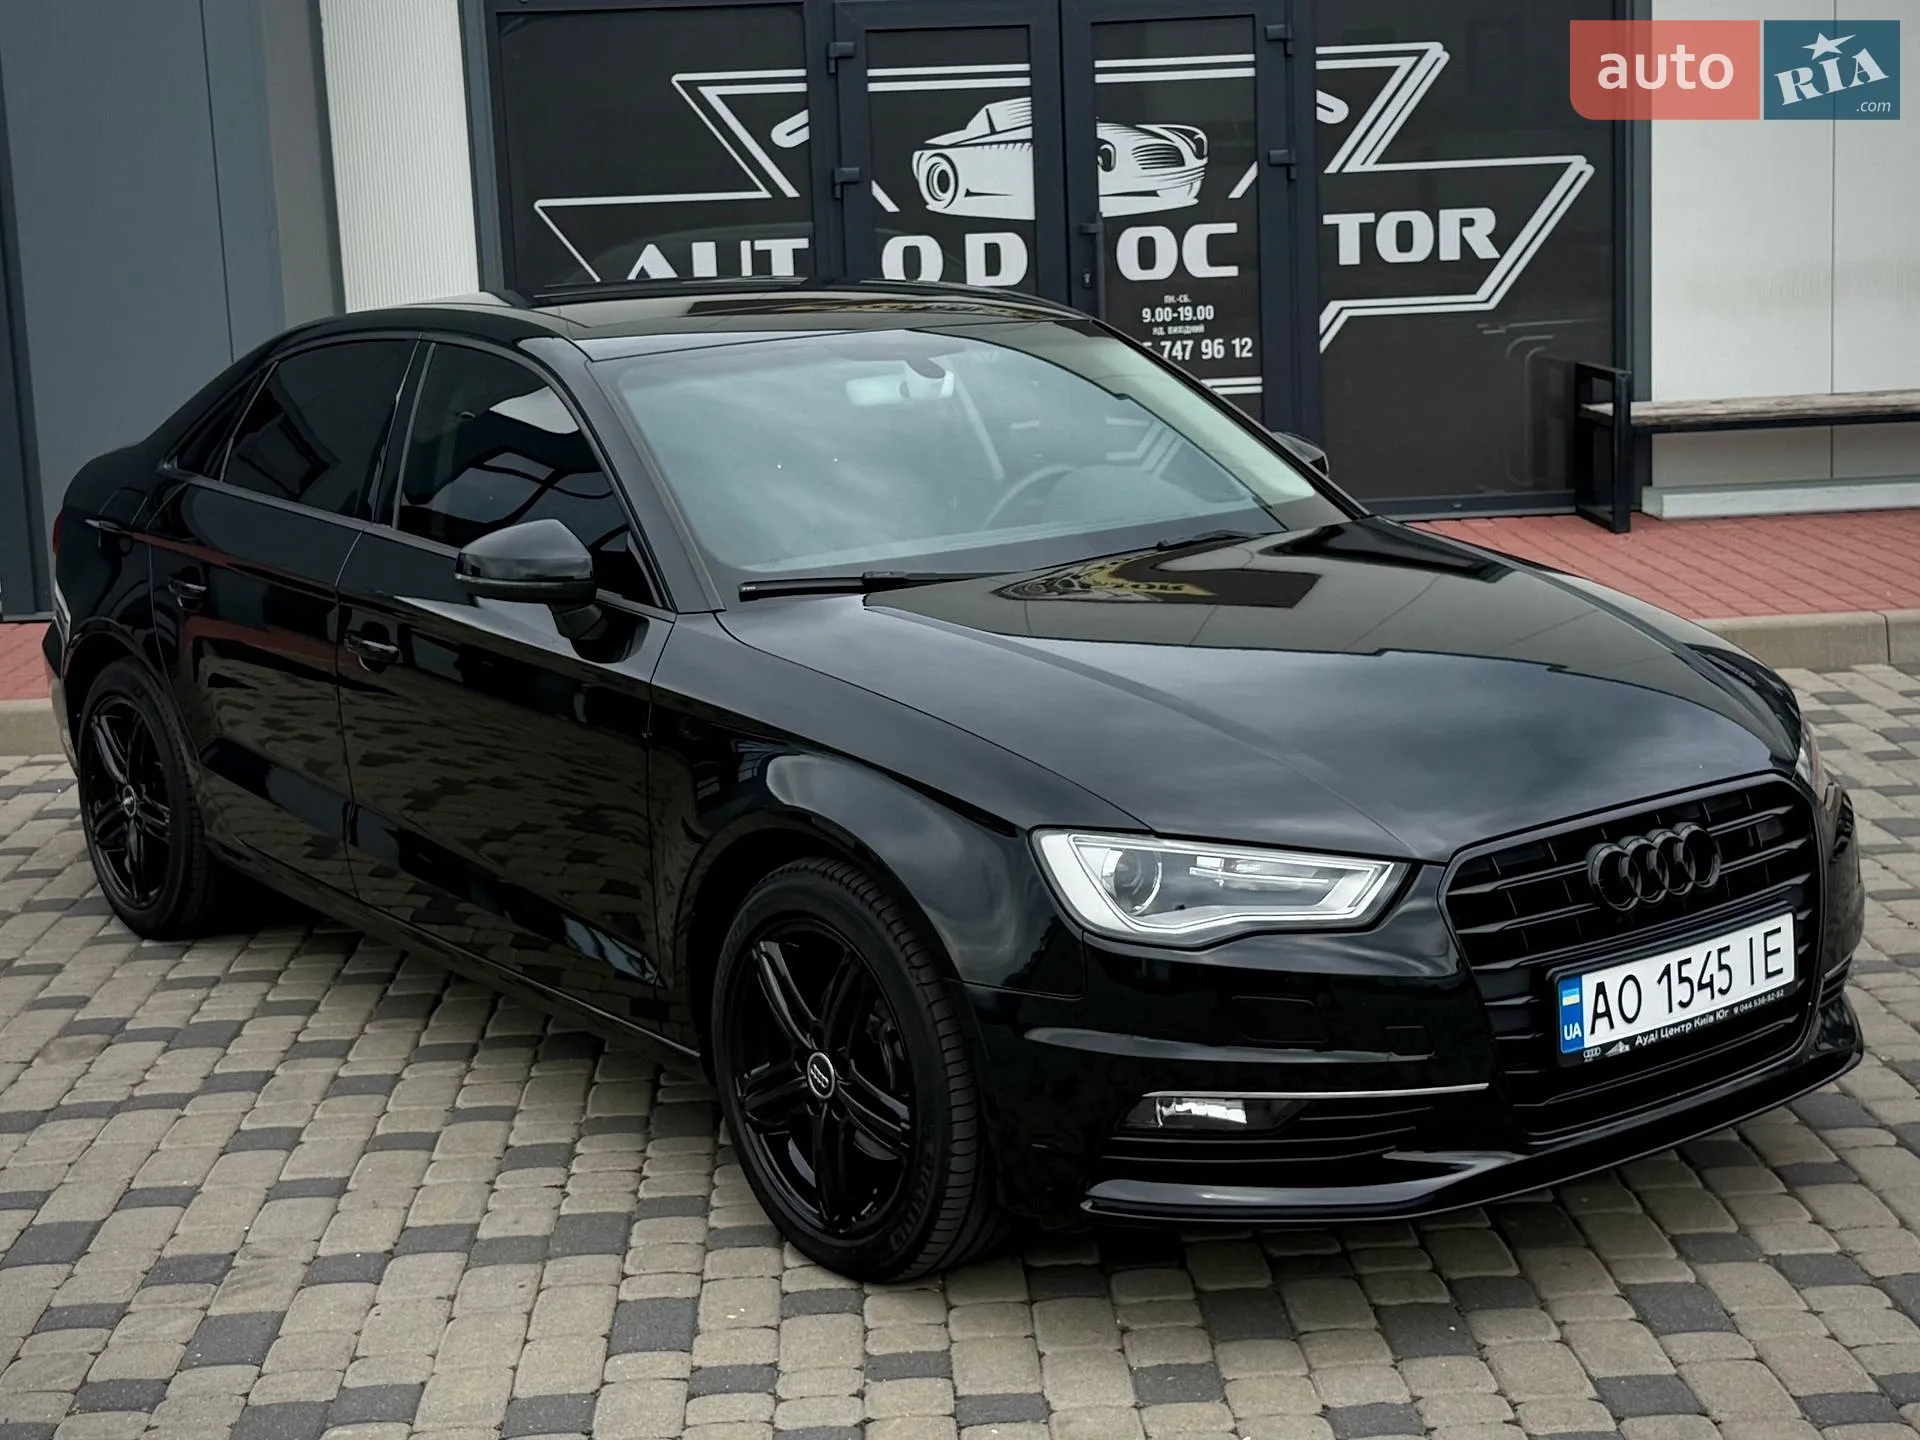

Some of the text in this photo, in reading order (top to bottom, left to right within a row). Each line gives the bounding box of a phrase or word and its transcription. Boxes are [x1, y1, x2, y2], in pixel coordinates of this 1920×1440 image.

[1141, 305, 1214, 323] 9.00-19.00
[1160, 337, 1253, 361] 747 96 12
[1589, 926, 1784, 1035] AO 1545 IE
[1563, 1022, 1582, 1041] UA
[1660, 1020, 1692, 1040] Центр
